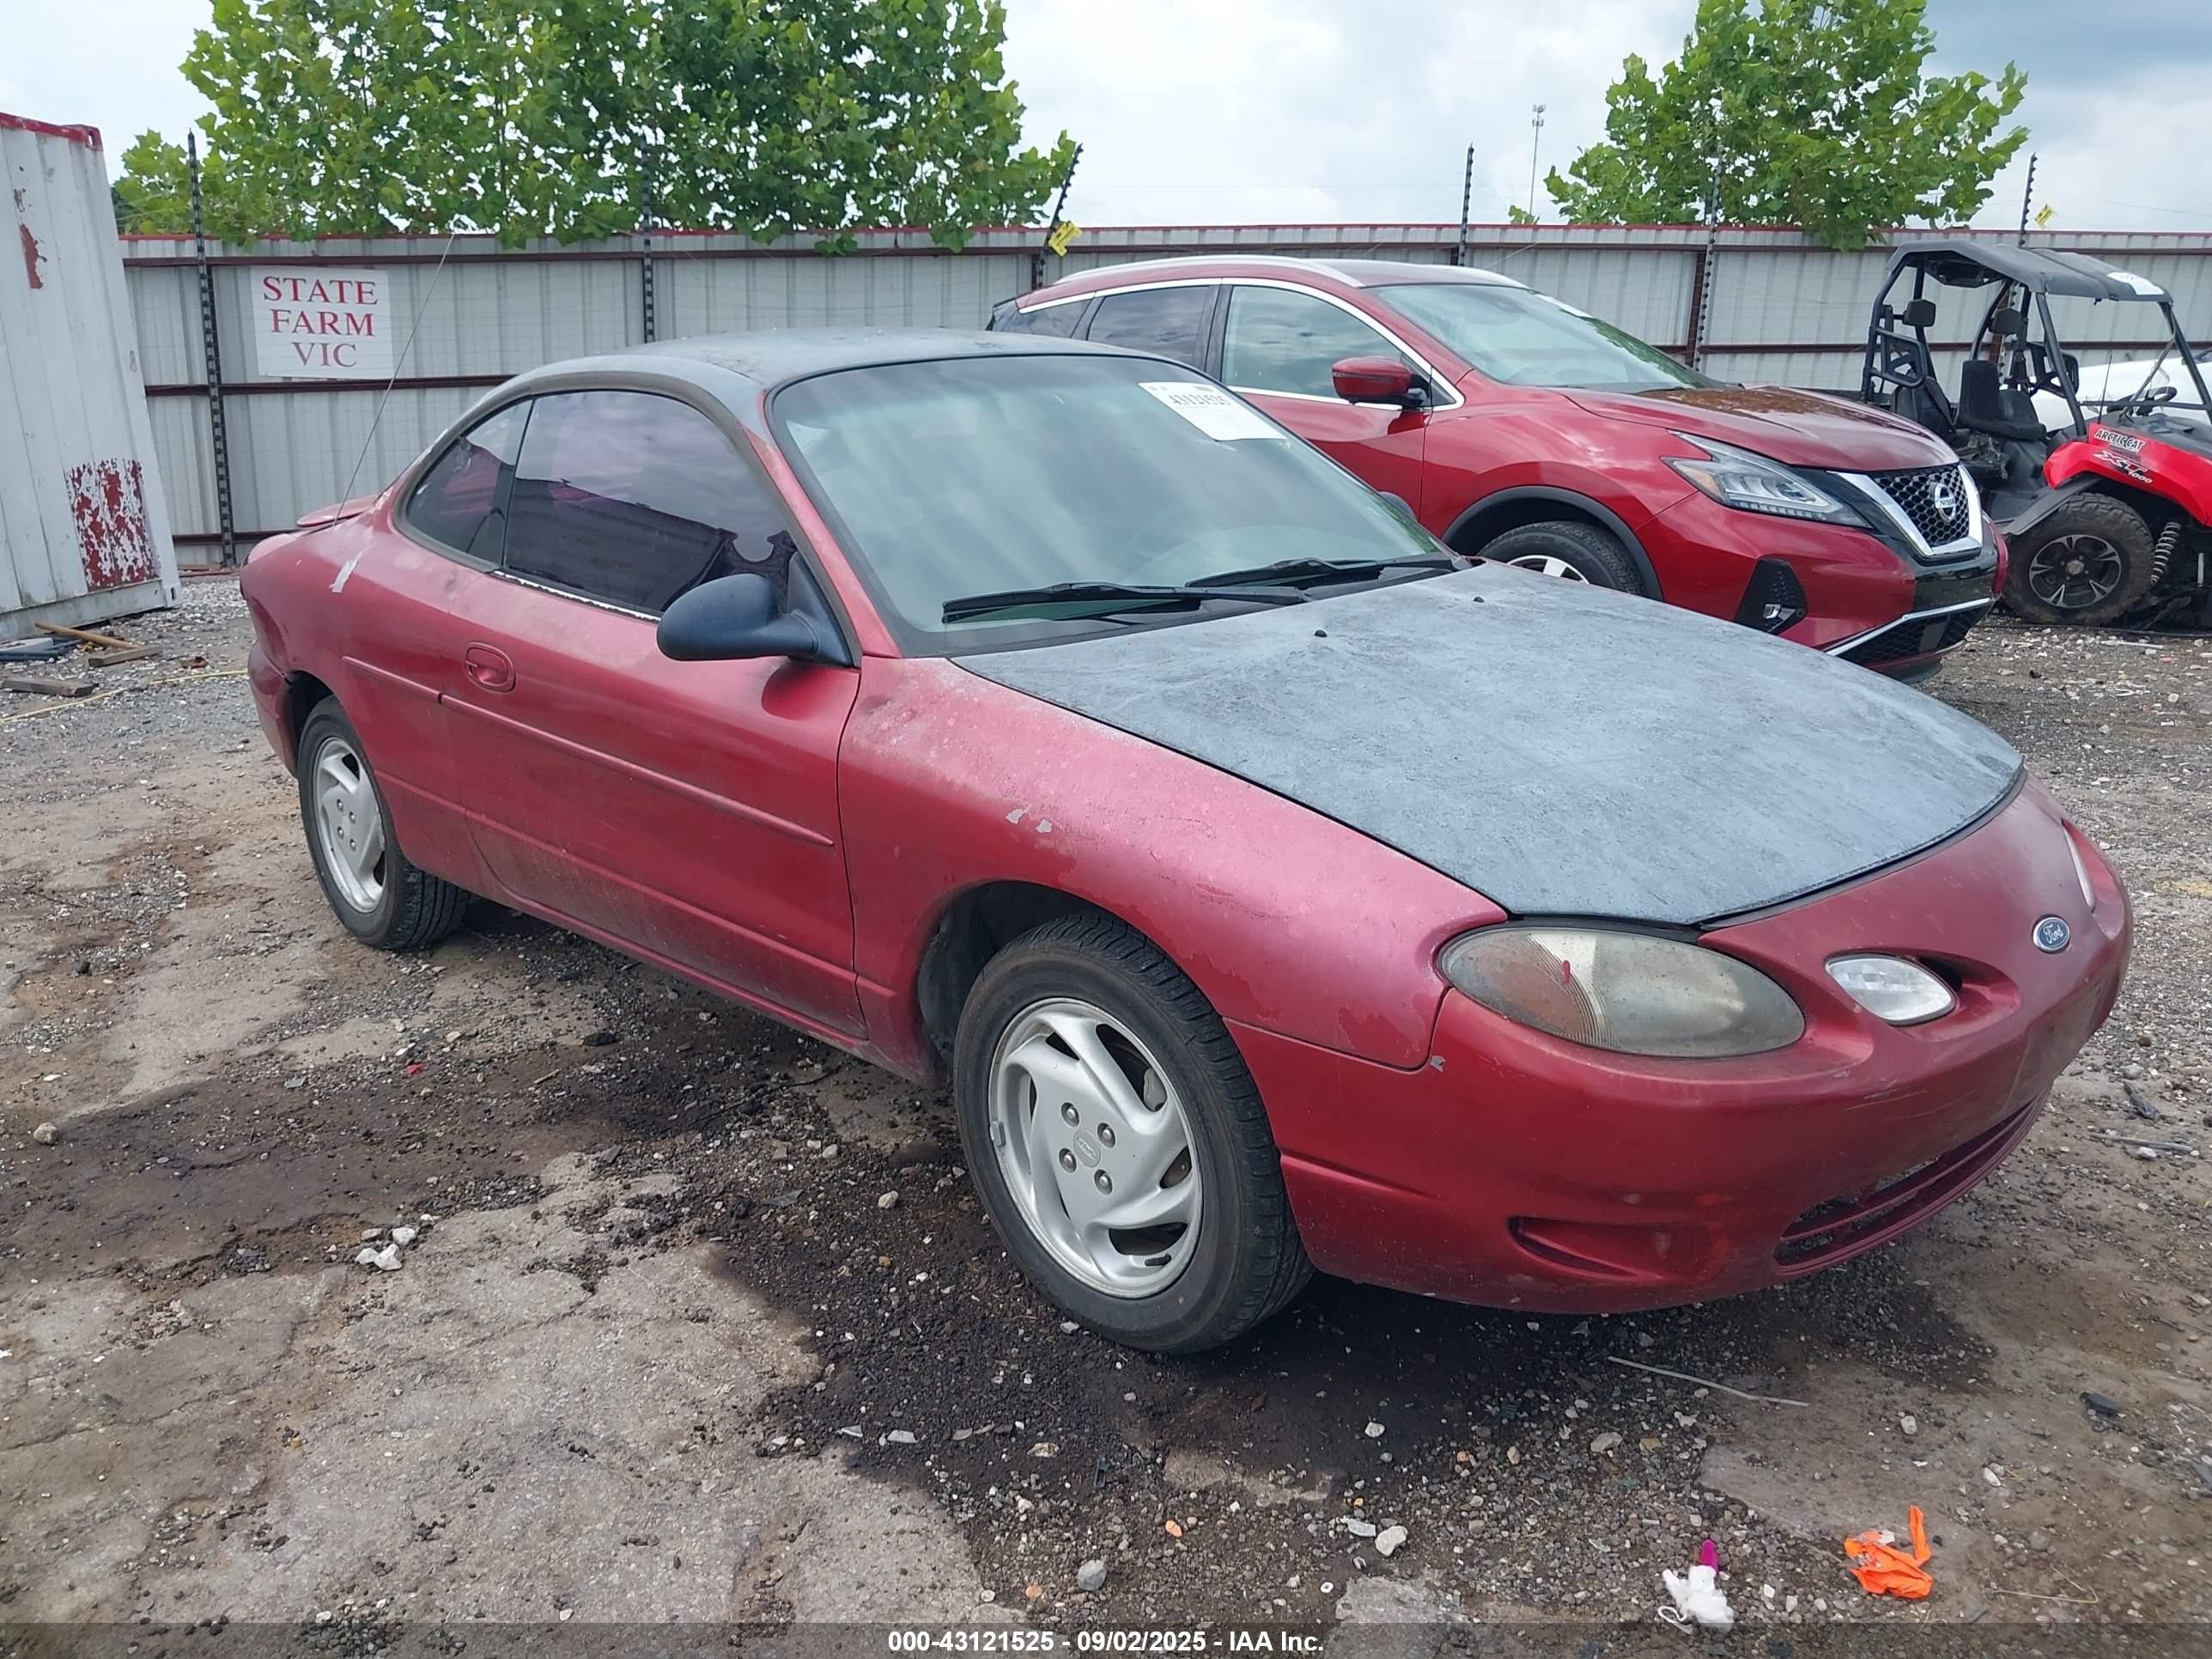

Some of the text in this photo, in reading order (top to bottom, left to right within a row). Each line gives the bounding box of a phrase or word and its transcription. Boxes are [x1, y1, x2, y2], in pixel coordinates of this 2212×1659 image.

[263, 276, 379, 305] STATE
[270, 308, 375, 337] FARM
[292, 342, 357, 368] VIC
[2096, 430, 2143, 449] ARCTIC CAT
[2129, 470, 2153, 483] 1000
[2043, 924, 2064, 945] Ford
